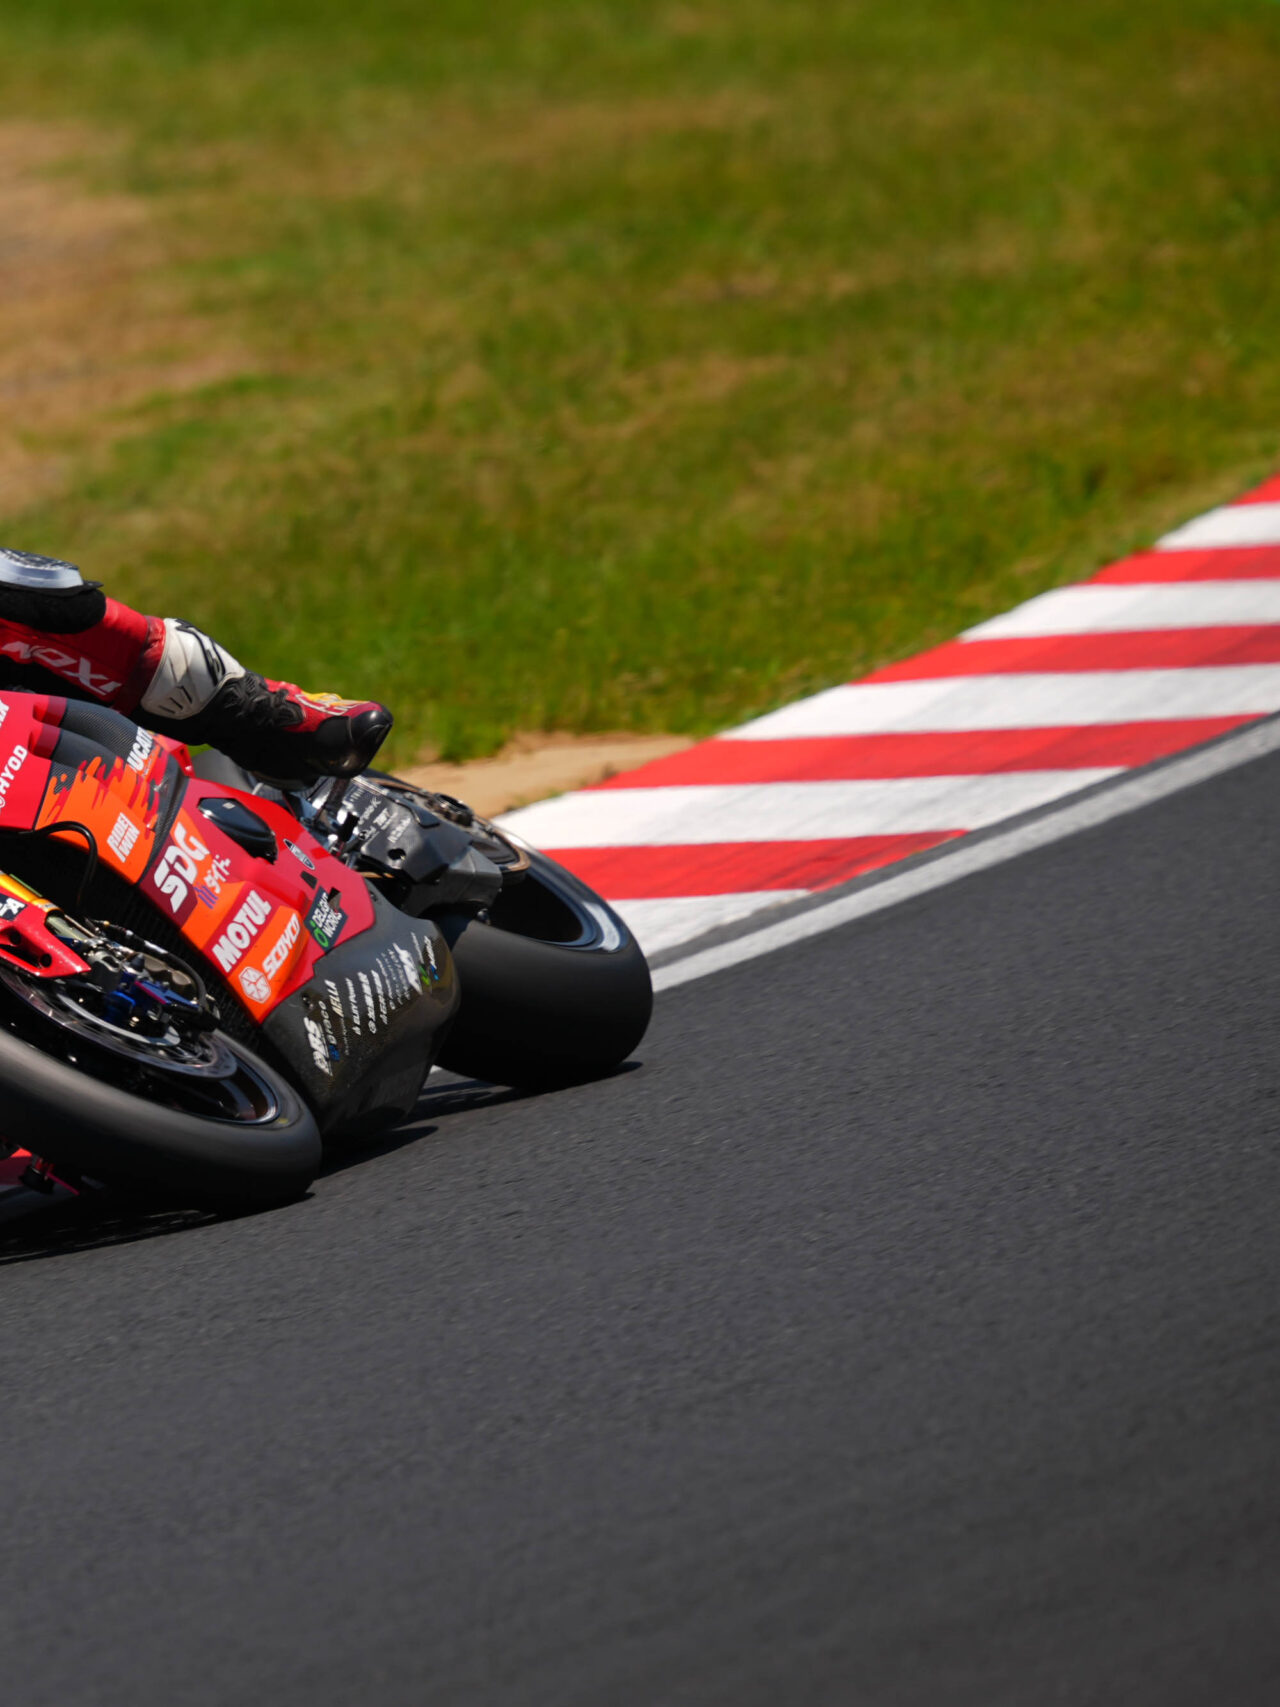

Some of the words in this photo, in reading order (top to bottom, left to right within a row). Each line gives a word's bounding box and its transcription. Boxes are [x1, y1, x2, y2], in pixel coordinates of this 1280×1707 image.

[154, 821, 211, 913] SDG
[211, 889, 272, 973] MOTUL
[262, 912, 301, 980] SCOYCO
